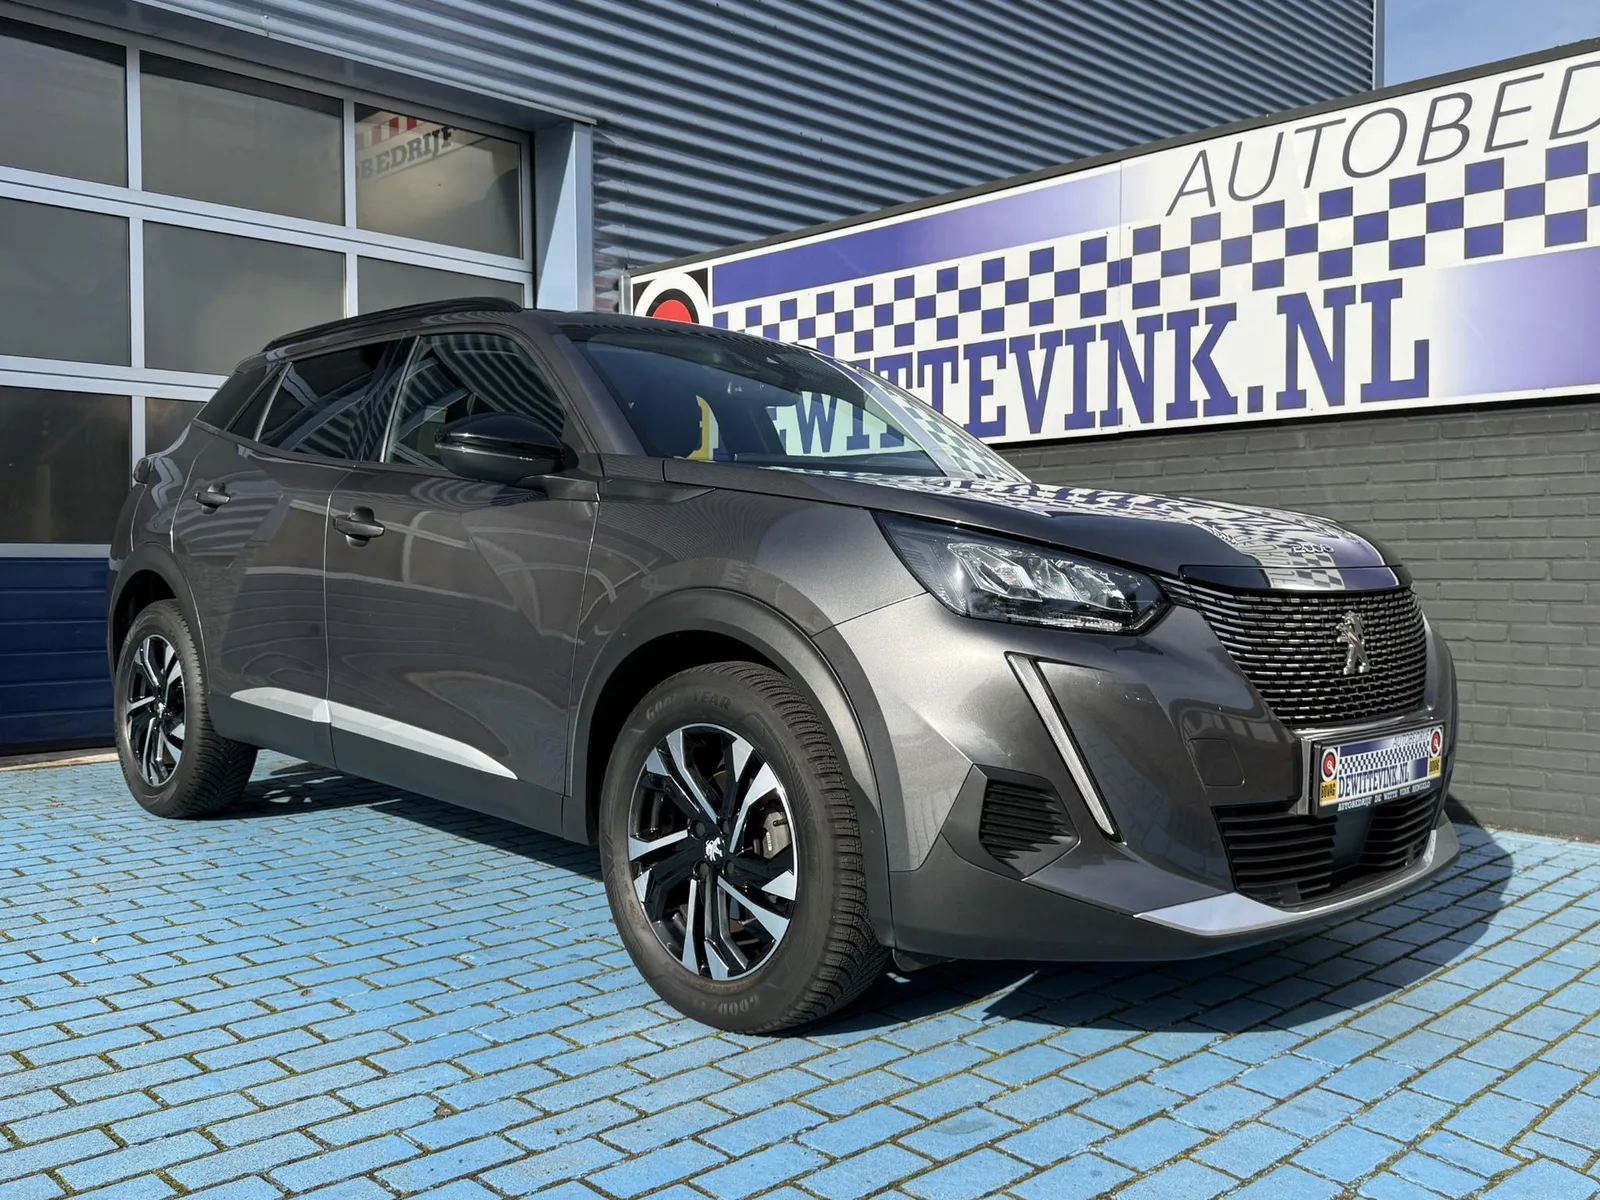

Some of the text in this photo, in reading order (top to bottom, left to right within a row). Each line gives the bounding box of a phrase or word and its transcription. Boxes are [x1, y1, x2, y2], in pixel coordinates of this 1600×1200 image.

[356, 126, 455, 179] BEDRIJF
[1165, 61, 1600, 217] AUTOBED
[1338, 797, 1372, 811] AUTOBEDRIJF
[1374, 794, 1383, 803] DE
[1383, 790, 1399, 801] WITTE
[1399, 786, 1411, 796] VINK
[1339, 763, 1409, 797] DEWITTEVINK.NL
